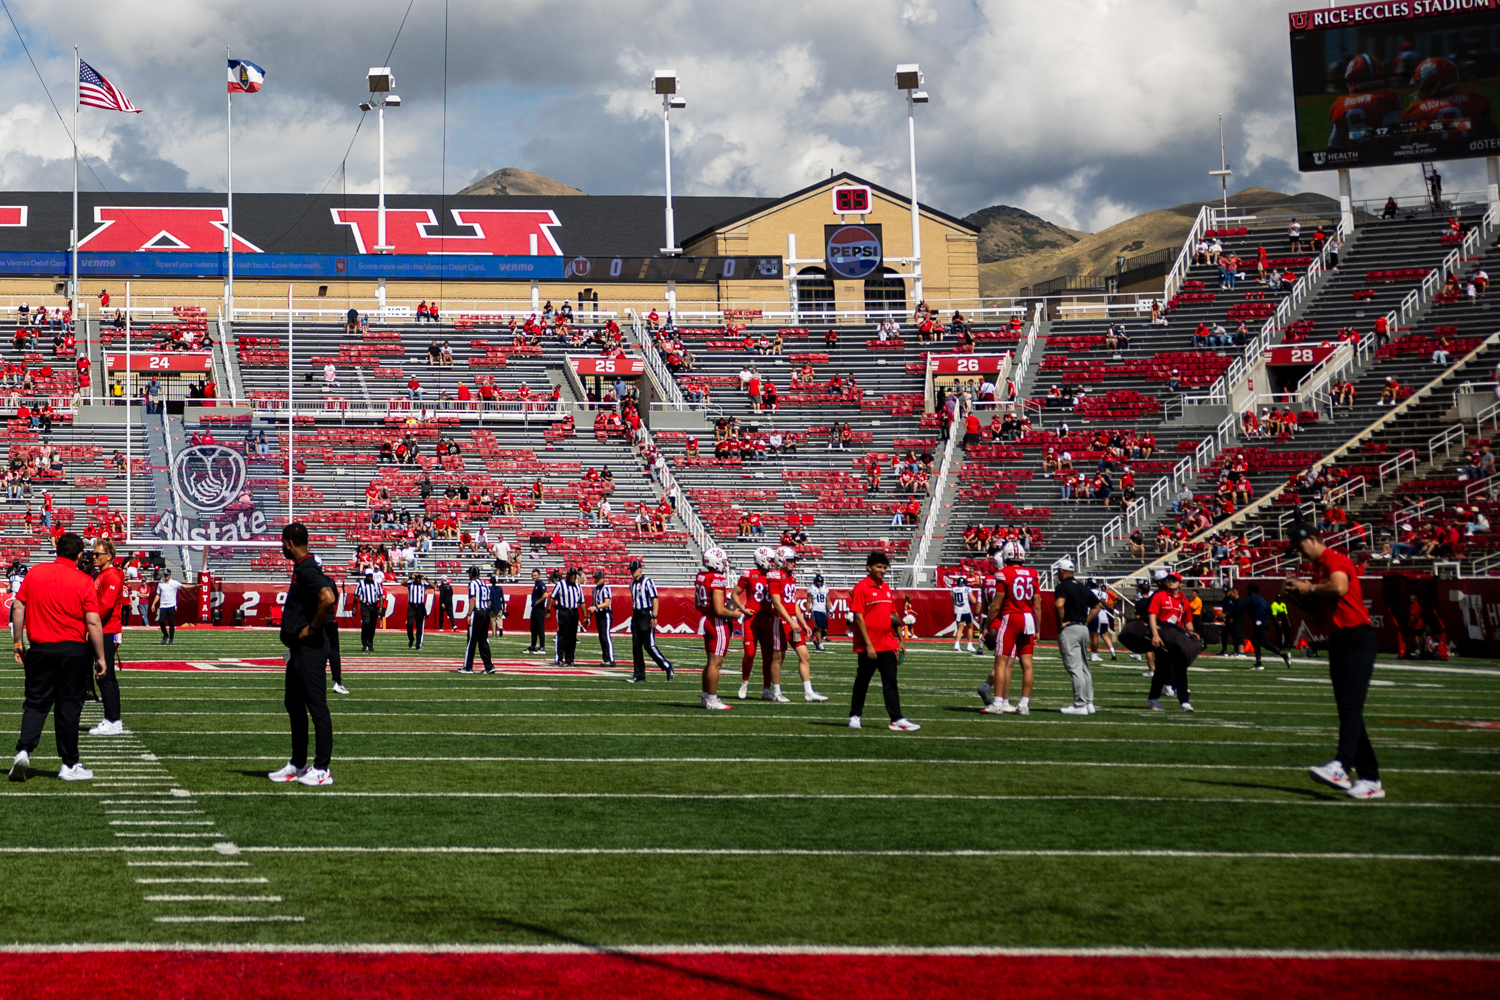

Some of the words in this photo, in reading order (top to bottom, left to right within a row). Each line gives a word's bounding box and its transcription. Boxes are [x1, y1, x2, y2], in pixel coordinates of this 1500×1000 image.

[1314, 3, 1409, 26] RICE-ECCLES
[1328, 151, 1358, 160] HEALTH
[831, 246, 877, 257] PEPSI
[81, 259, 116, 267] venmo
[156, 261, 178, 269] Spend
[425, 263, 448, 271] Venmo
[499, 263, 534, 271] venmo
[1291, 350, 1314, 362] 28
[150, 357, 170, 369] 24
[595, 360, 616, 373] 25
[957, 359, 979, 372] 26
[153, 509, 268, 552] Allstate
[1012, 577, 1034, 601] 65
[816, 594, 825, 603] 18
